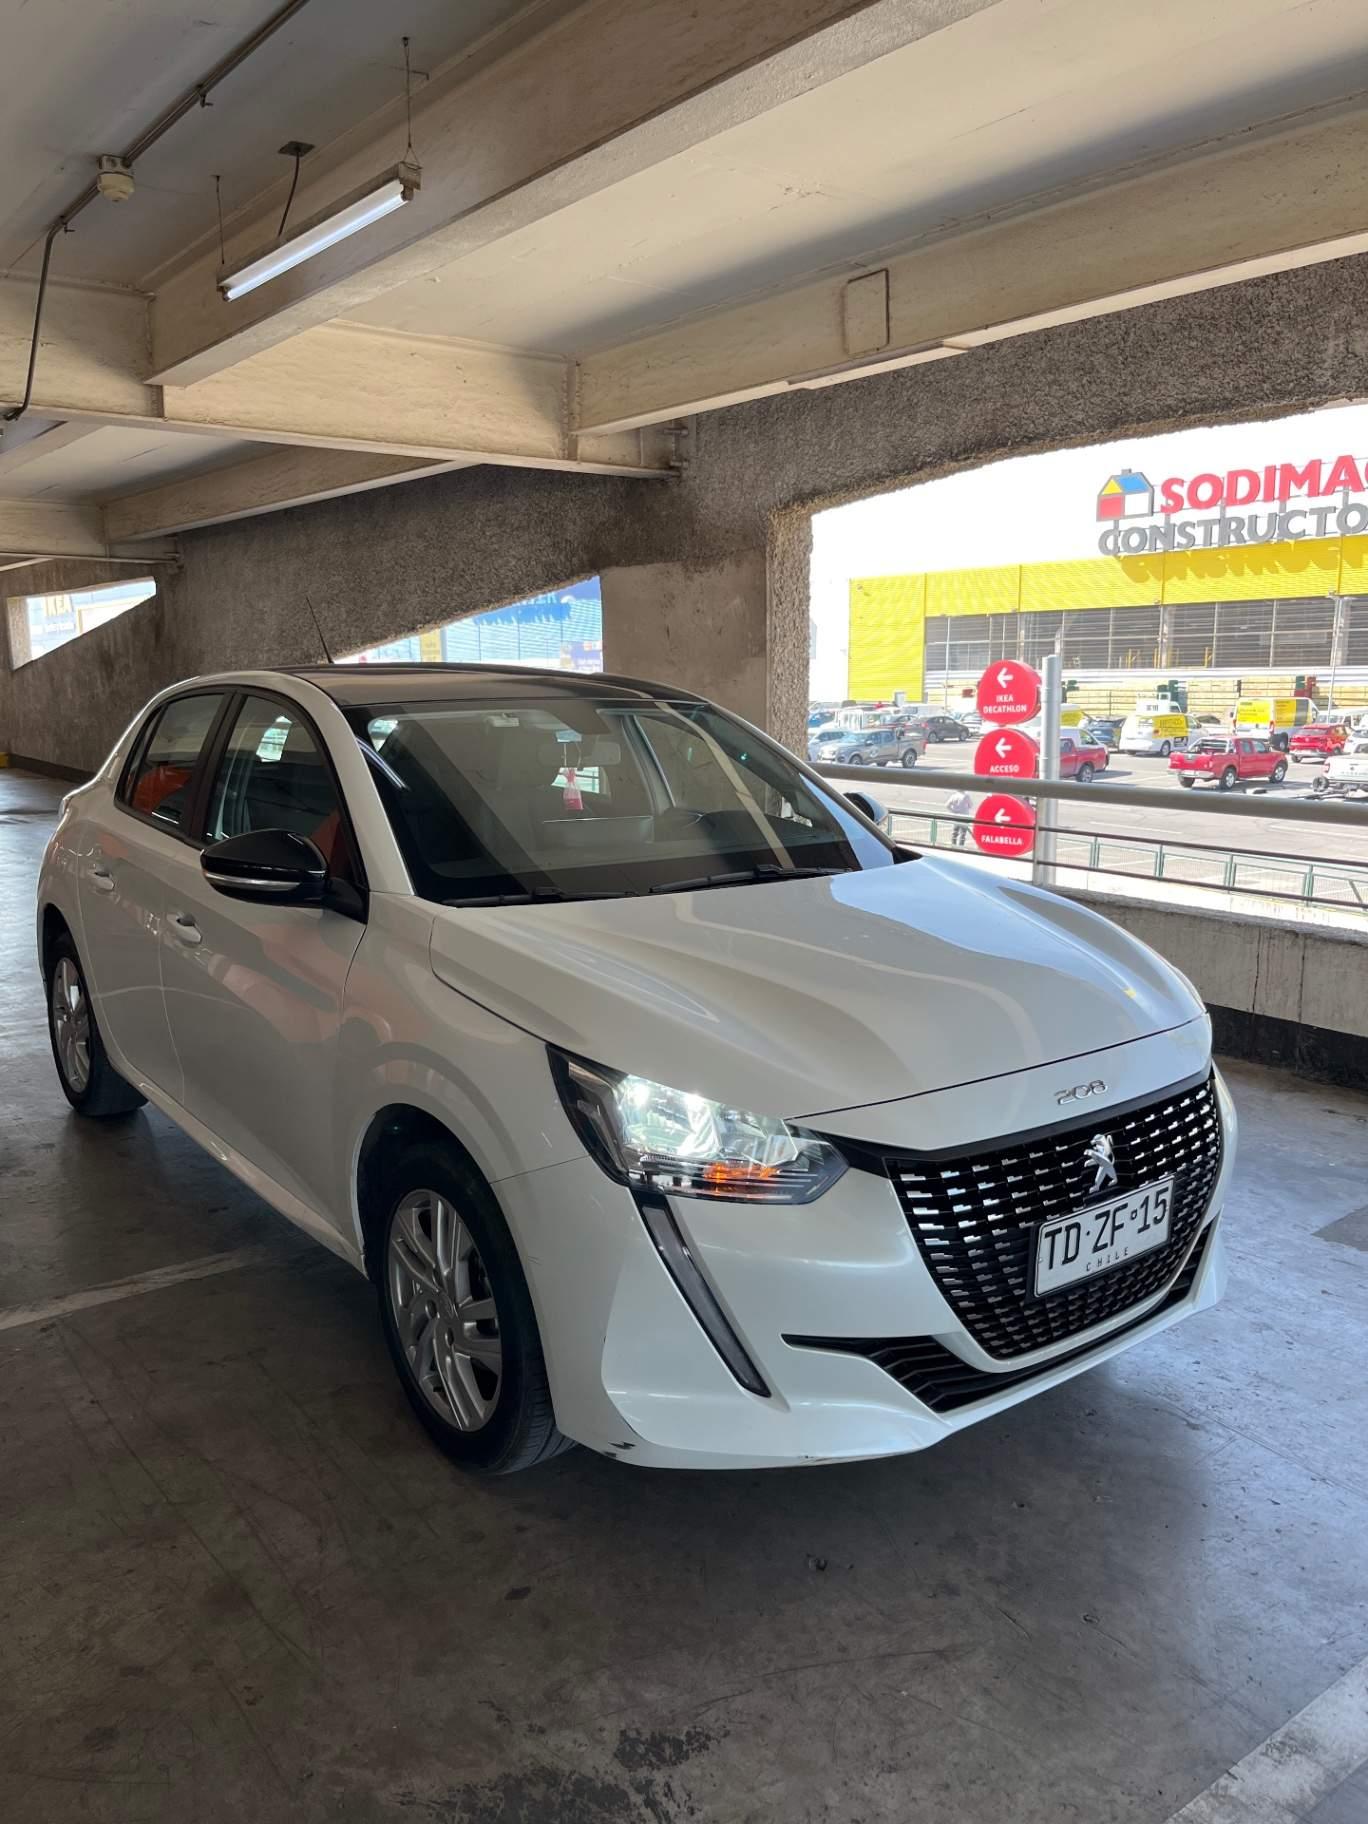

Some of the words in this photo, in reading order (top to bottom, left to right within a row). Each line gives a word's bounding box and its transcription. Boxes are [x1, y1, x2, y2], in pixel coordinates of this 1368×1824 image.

[1160, 455, 1368, 514] SODIMA
[996, 694, 1013, 703] IKEA
[983, 704, 1027, 714] DECATHLON
[989, 764, 1020, 773] ACCESO
[981, 834, 1023, 846] FALABELLA
[1055, 1079, 1108, 1105] 208
[1086, 1246, 1130, 1273] CHILE
